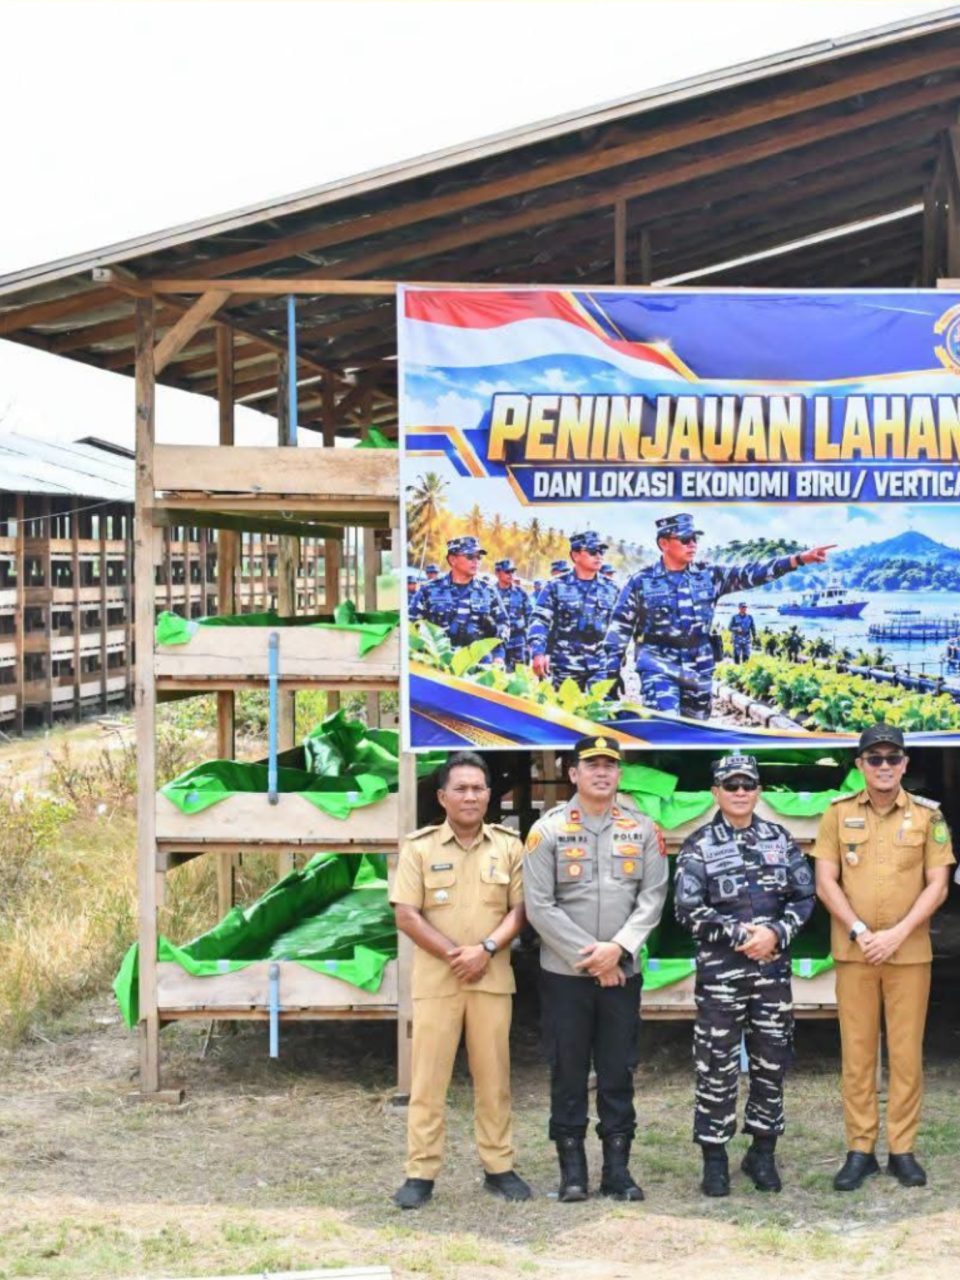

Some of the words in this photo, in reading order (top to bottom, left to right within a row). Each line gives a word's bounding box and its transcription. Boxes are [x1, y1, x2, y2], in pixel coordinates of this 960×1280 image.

[486, 393, 803, 462] PENINJAUAN
[533, 470, 583, 497] DAN
[588, 470, 674, 497] LOKASI
[681, 470, 789, 497] EKONOMI
[613, 833, 643, 841] POLRI
